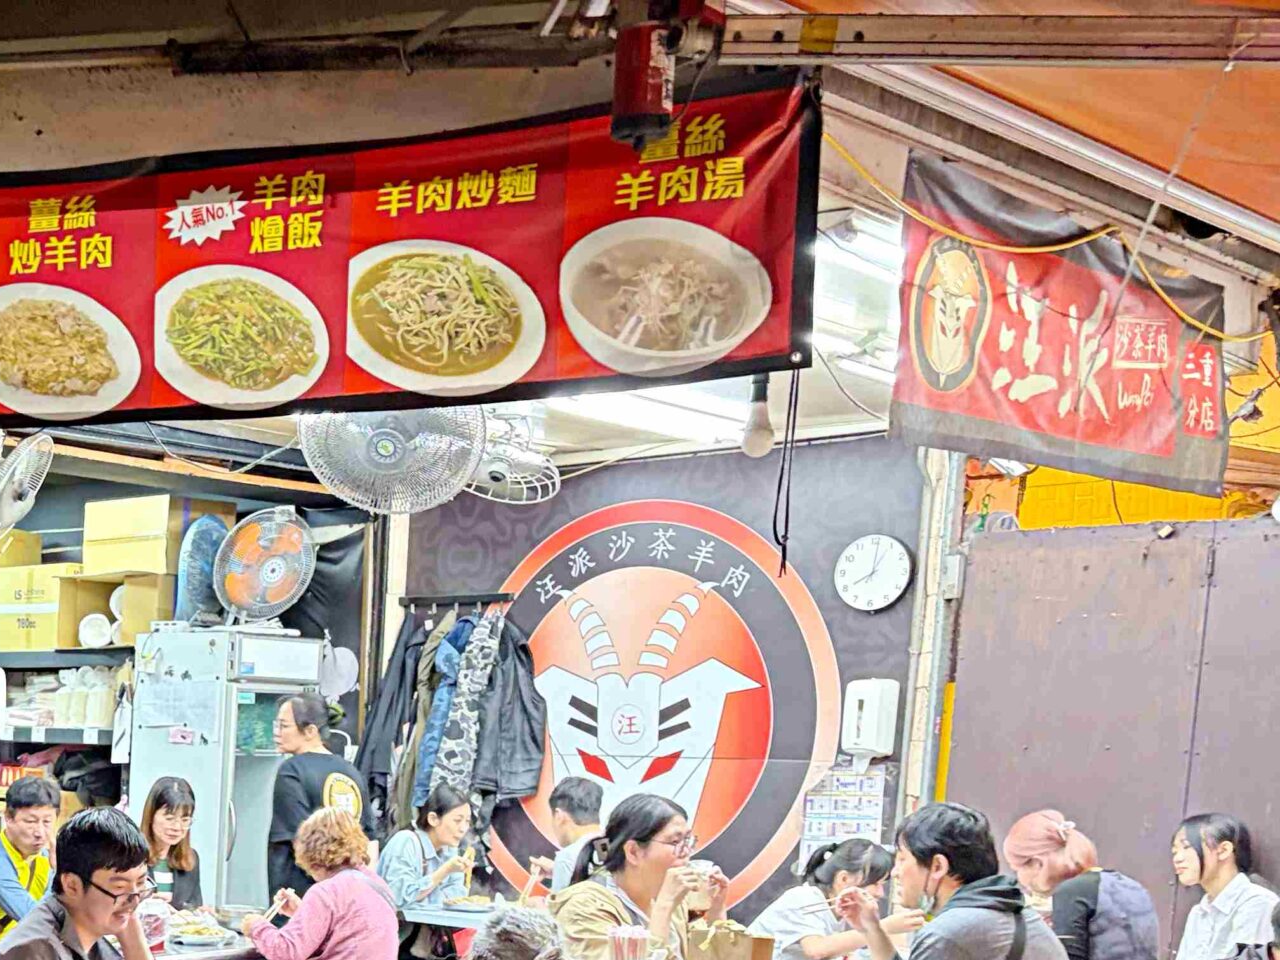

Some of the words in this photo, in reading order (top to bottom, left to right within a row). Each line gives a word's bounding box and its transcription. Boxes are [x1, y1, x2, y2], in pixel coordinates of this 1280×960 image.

[251, 169, 326, 211] 羊肉
[376, 163, 537, 218] 羊肉炒麵
[615, 157, 745, 212] 羊肉湯
[27, 195, 97, 235] 薑絲
[179, 197, 236, 232] 人氣No.1
[249, 210, 325, 254] 燴飯
[9, 233, 113, 276] 炒羊肉
[992, 260, 1116, 427] 汪派
[1117, 323, 1169, 361] 沙茶羊肉
[1181, 351, 1214, 387] 三重
[1184, 393, 1215, 431] 分店
[535, 528, 753, 604] 汪派沙茶羊肉
[617, 714, 641, 736] 汪
